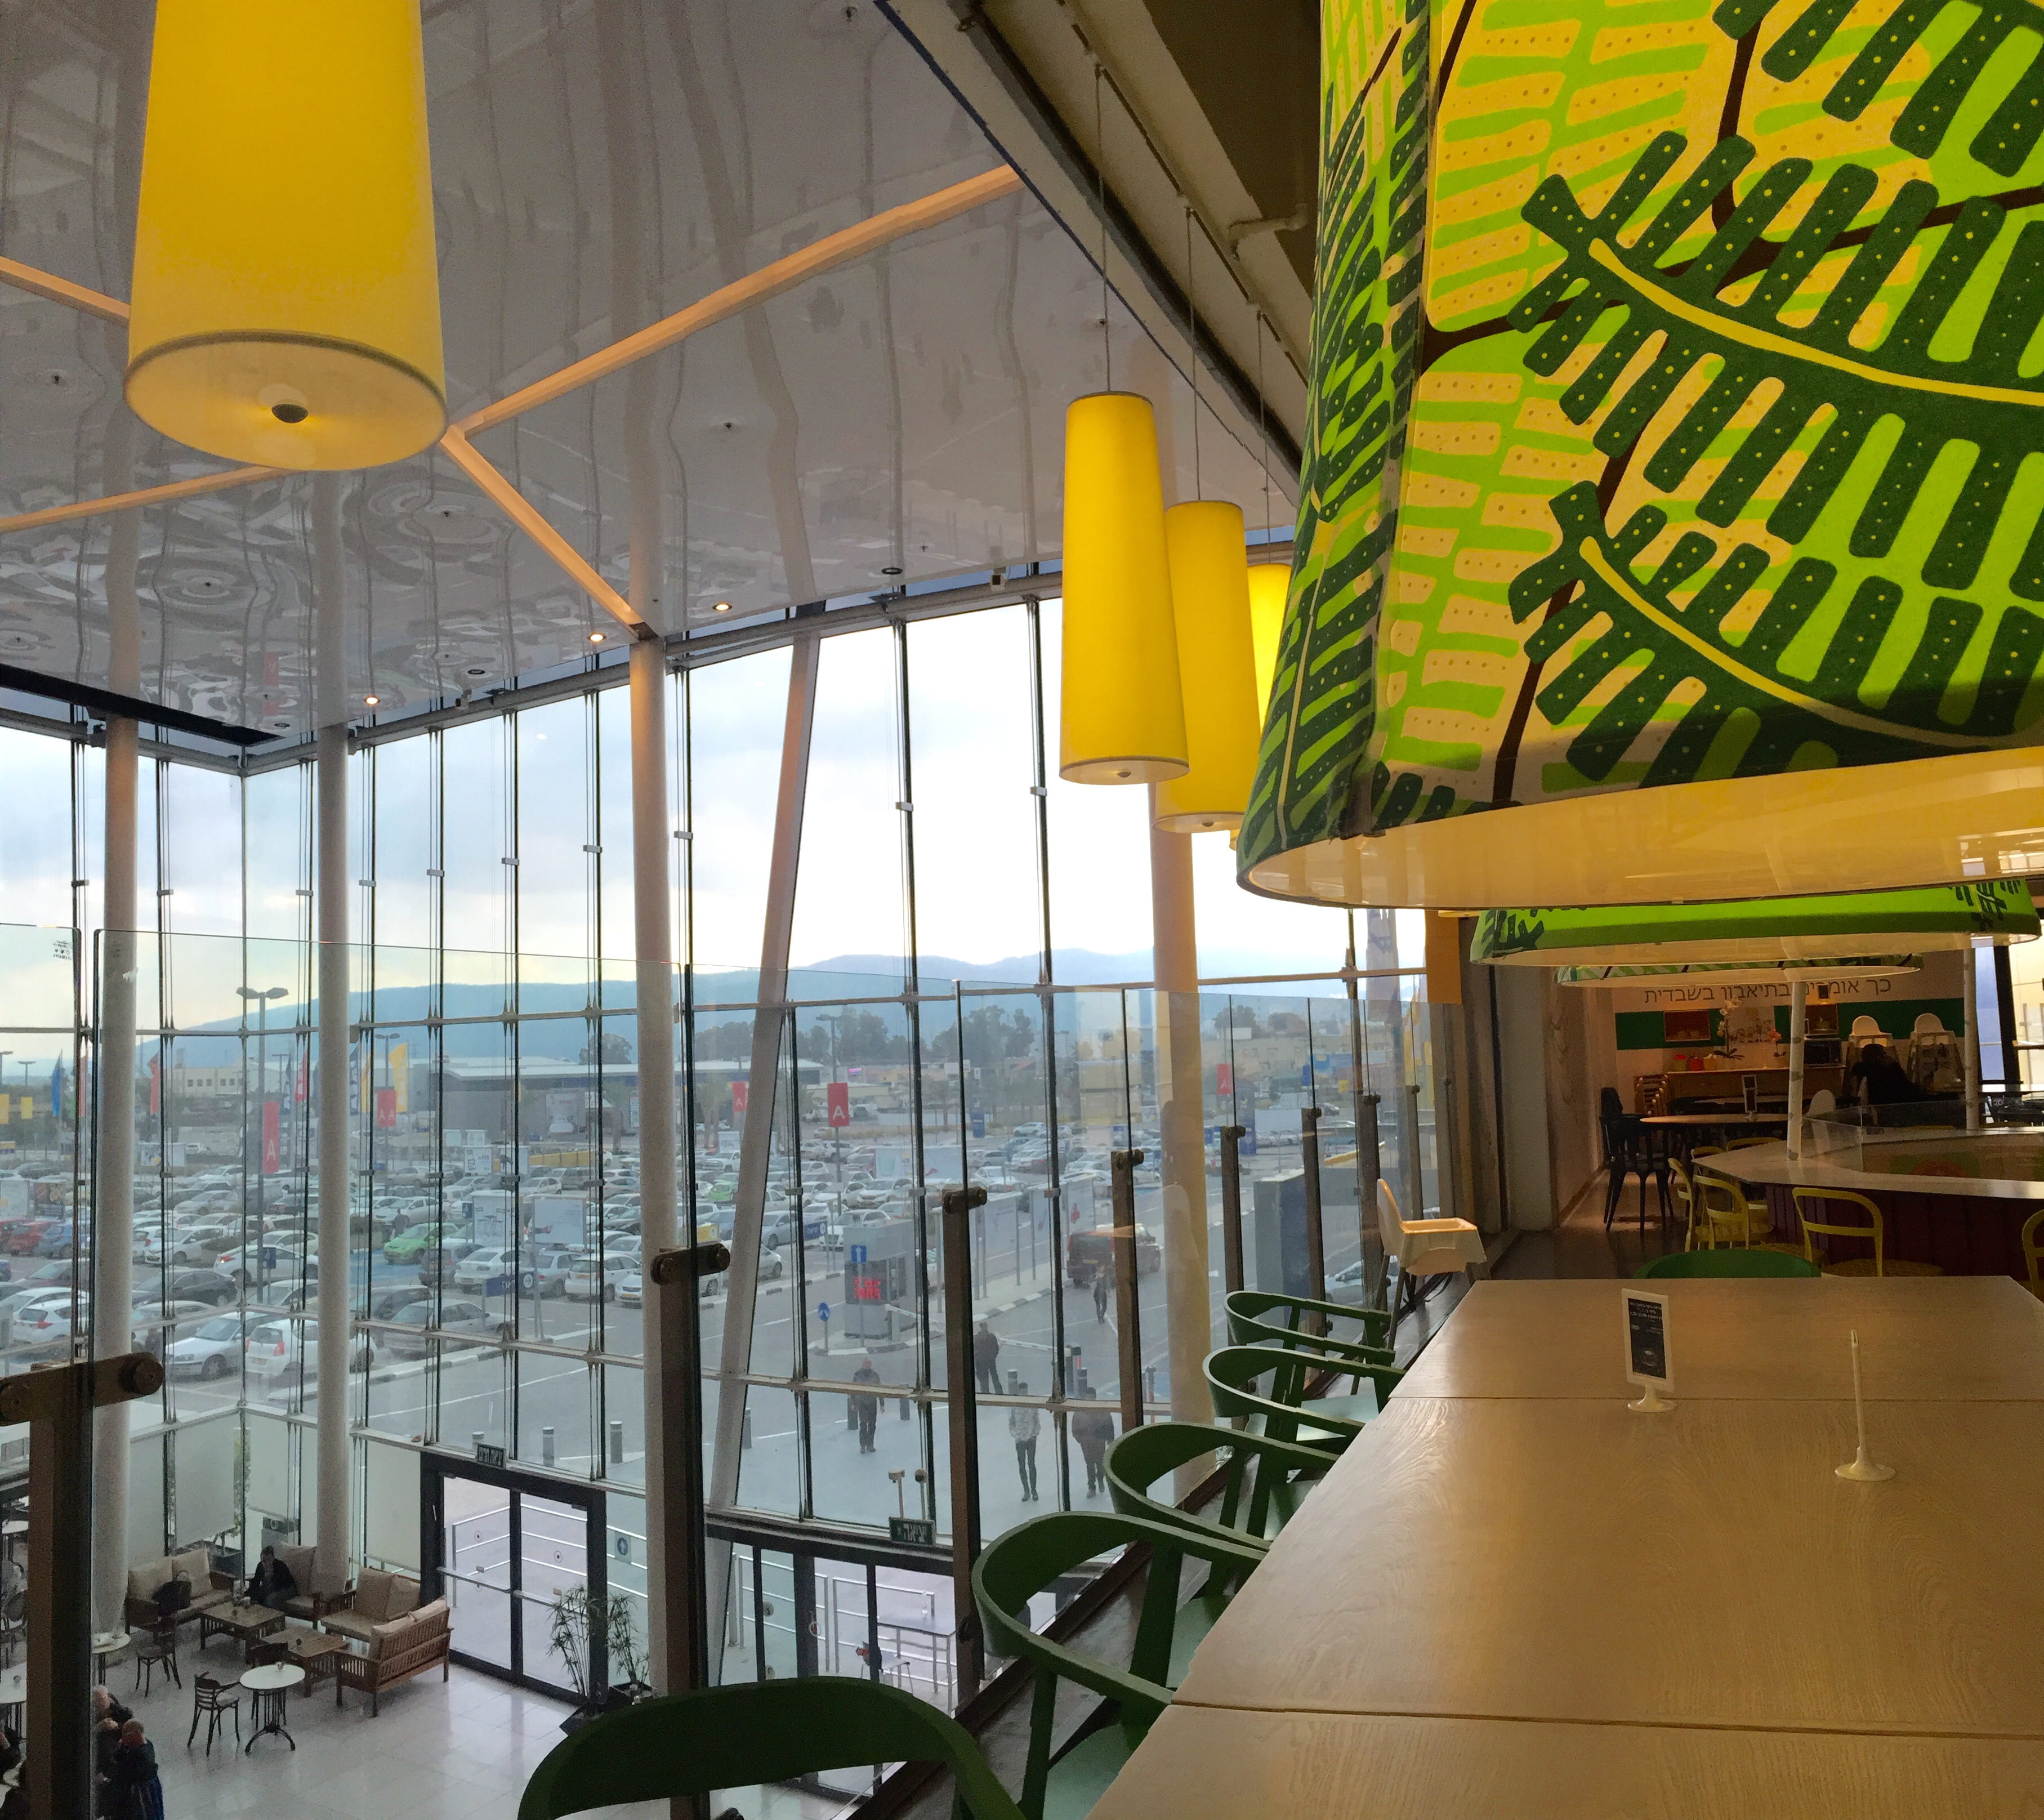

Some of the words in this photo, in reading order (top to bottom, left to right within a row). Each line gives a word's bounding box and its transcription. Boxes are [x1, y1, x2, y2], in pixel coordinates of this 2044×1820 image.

[1866, 979, 1891, 996] כך
[1645, 988, 1715, 1003] בשבדית
[1220, 1079, 1227, 1089] A
[735, 1098, 743, 1107] A
[378, 1109, 385, 1121] A
[388, 1109, 395, 1121] A
[833, 1105, 845, 1119] A
[266, 1139, 276, 1162] A
